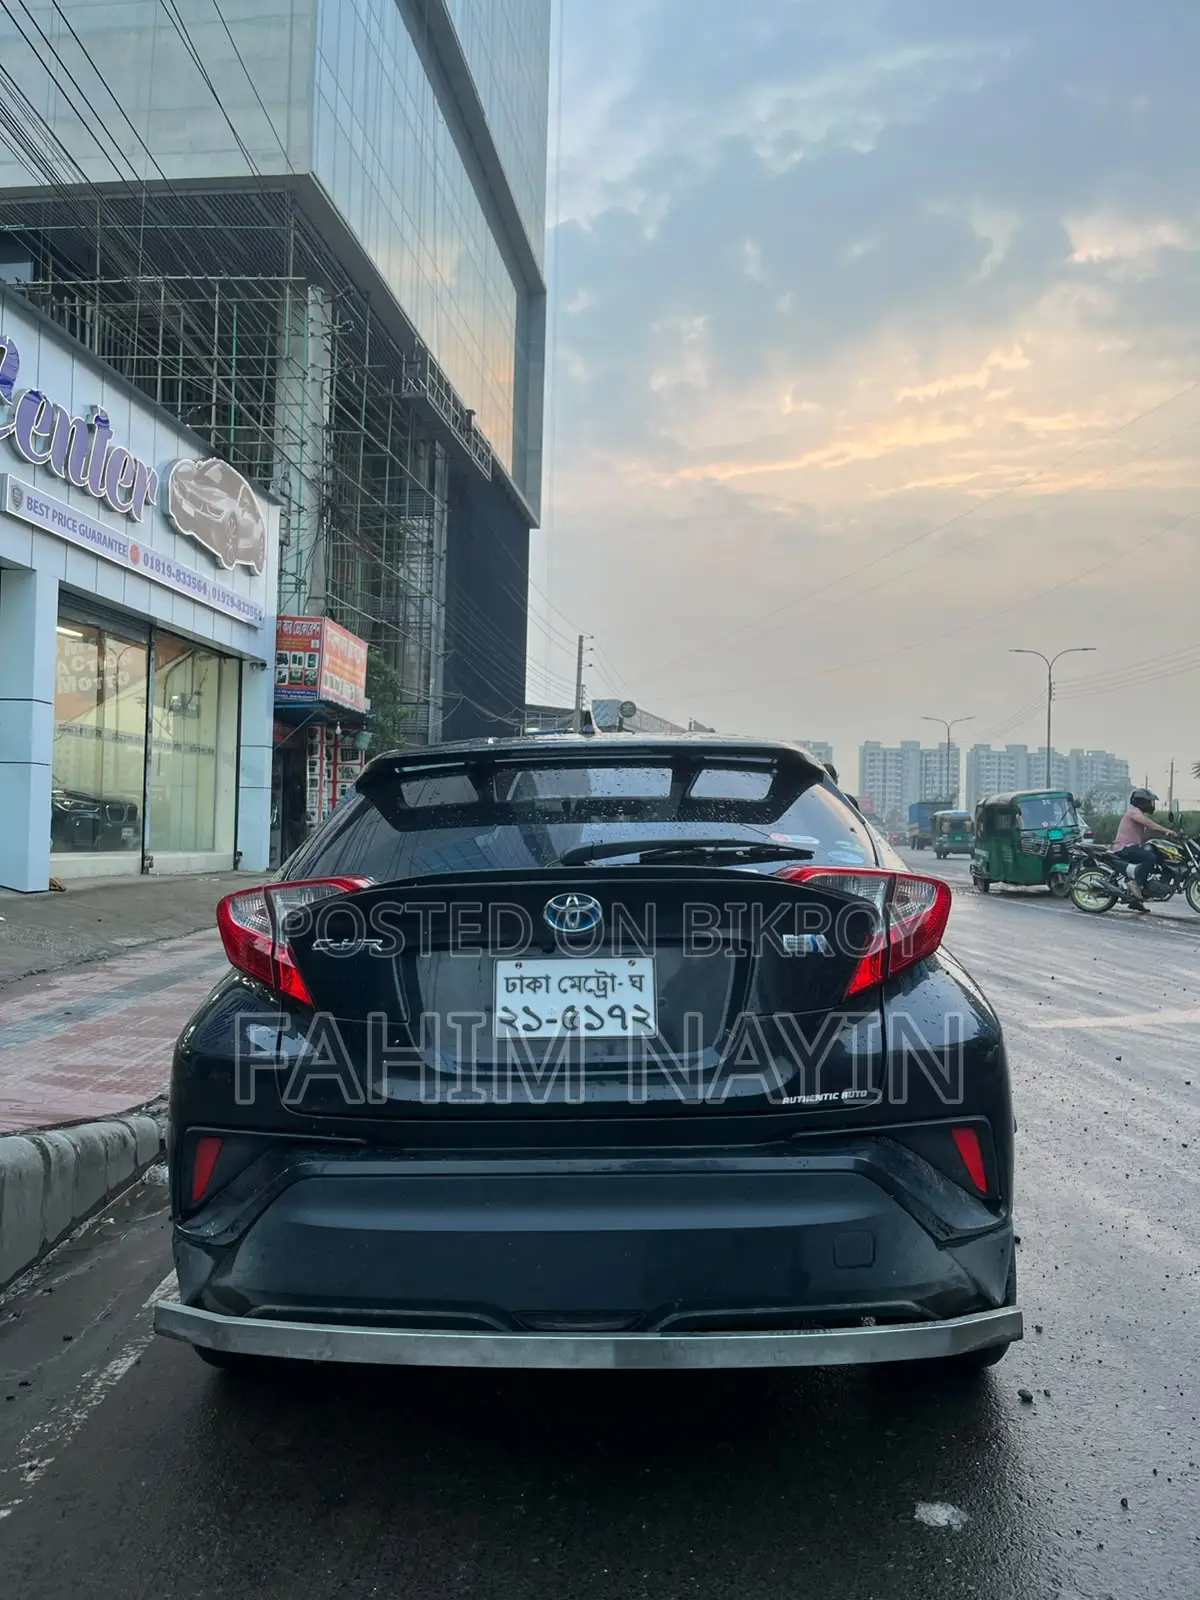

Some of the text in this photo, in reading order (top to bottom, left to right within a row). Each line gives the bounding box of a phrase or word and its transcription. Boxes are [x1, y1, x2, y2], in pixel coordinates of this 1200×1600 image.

[26, 495, 129, 557] BEST PRICE GUARANTEE
[503, 973, 551, 995] ঢাকা
[499, 1003, 654, 1032] ২১-৫১৭২
[781, 1089, 868, 1105] AUTHENTIC AUTO
